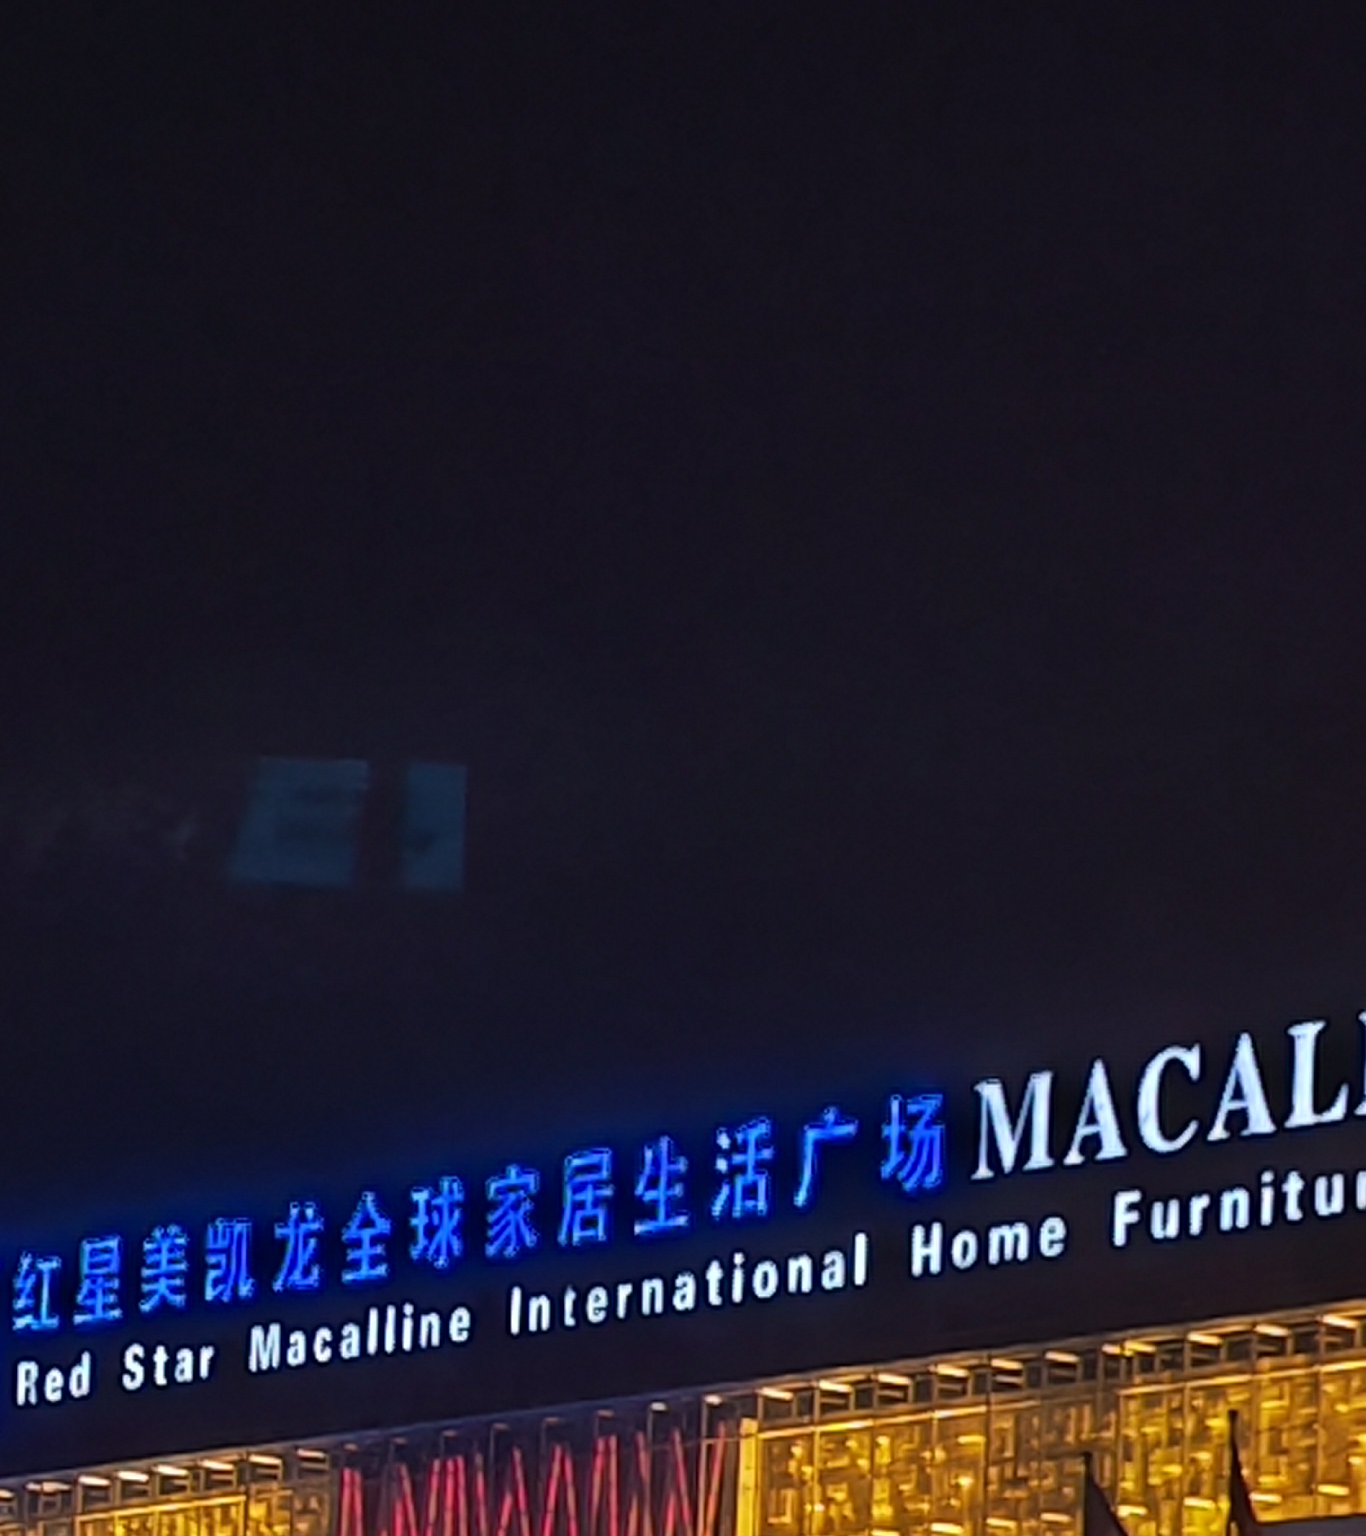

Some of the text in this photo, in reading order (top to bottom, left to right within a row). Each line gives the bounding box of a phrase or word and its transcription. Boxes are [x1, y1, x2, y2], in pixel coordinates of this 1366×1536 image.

[11, 1094, 945, 1332] 红星美凯龙全球家居生活广场
[15, 1352, 91, 1405] Red
[122, 1341, 215, 1391] Star
[249, 1303, 471, 1373] Macalline
[509, 1232, 868, 1335] International
[910, 1215, 1067, 1278] Home
